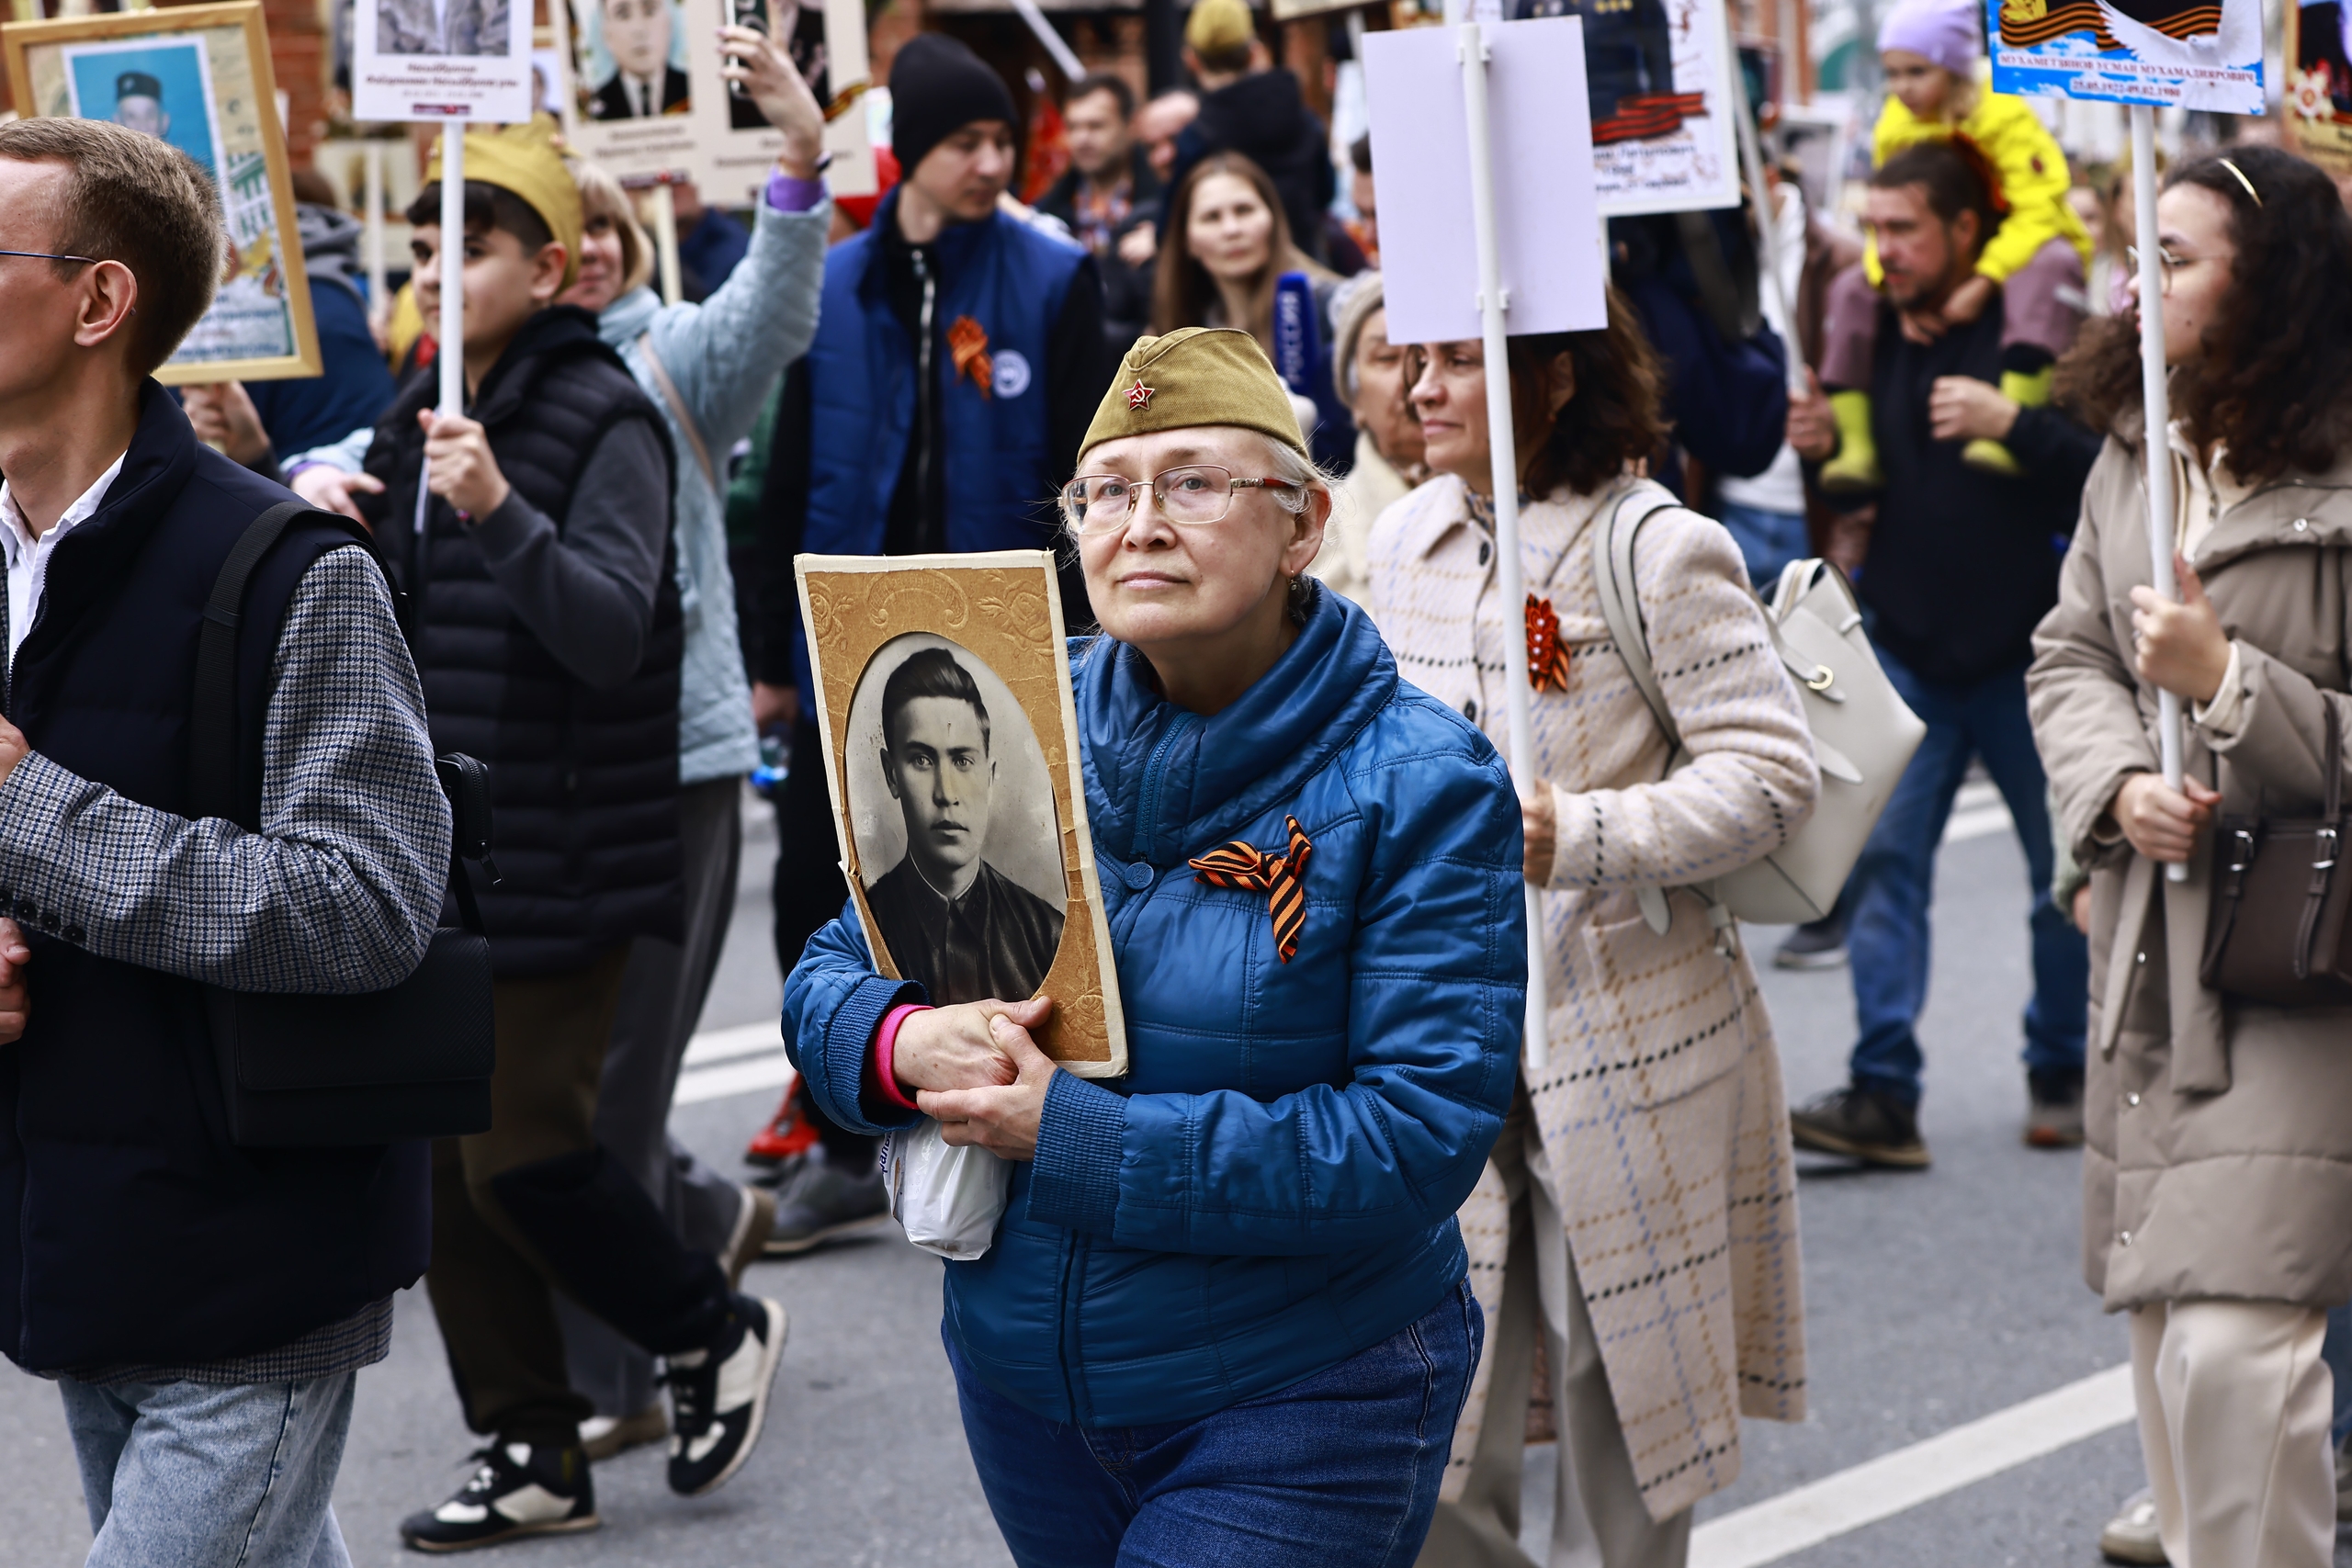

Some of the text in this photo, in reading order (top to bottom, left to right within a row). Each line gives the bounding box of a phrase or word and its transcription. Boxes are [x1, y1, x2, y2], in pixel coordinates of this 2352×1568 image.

[2000, 55, 2255, 82] МУХАМЕТЗЯНОВ УСМАН МУХАМАДИЯРОВИЧ
[1277, 290, 1305, 385] РОССИЯ
